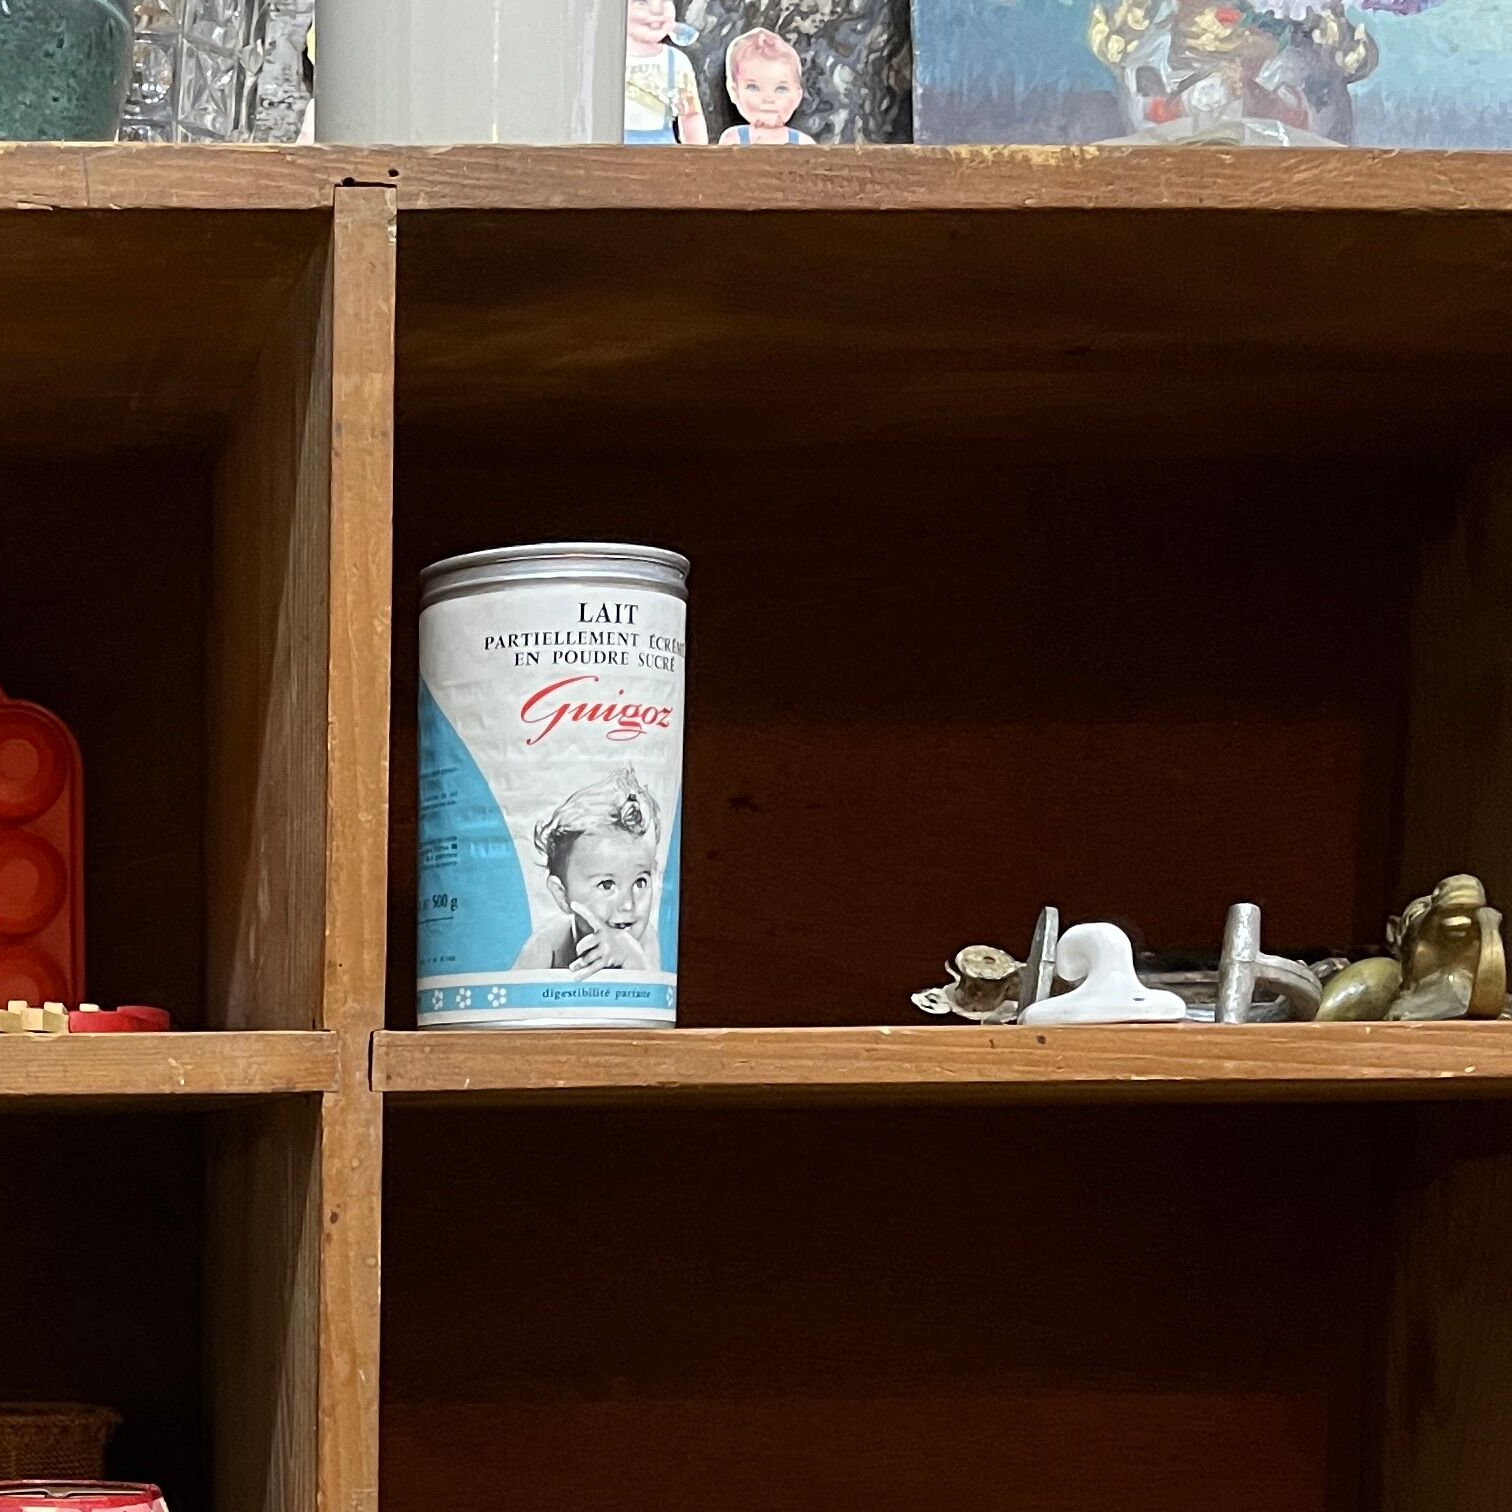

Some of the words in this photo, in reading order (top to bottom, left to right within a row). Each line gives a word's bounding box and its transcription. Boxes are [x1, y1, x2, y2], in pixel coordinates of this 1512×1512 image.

[578, 602, 638, 625] LAIT
[484, 631, 640, 650] PARTIELLEMENT
[514, 651, 540, 667] EN
[552, 649, 630, 666] POUDRE
[638, 652, 675, 672] SUCRÉ
[520, 675, 673, 746] Guigoz
[432, 893, 448, 909] 500
[542, 987, 610, 1000] digestibilité
